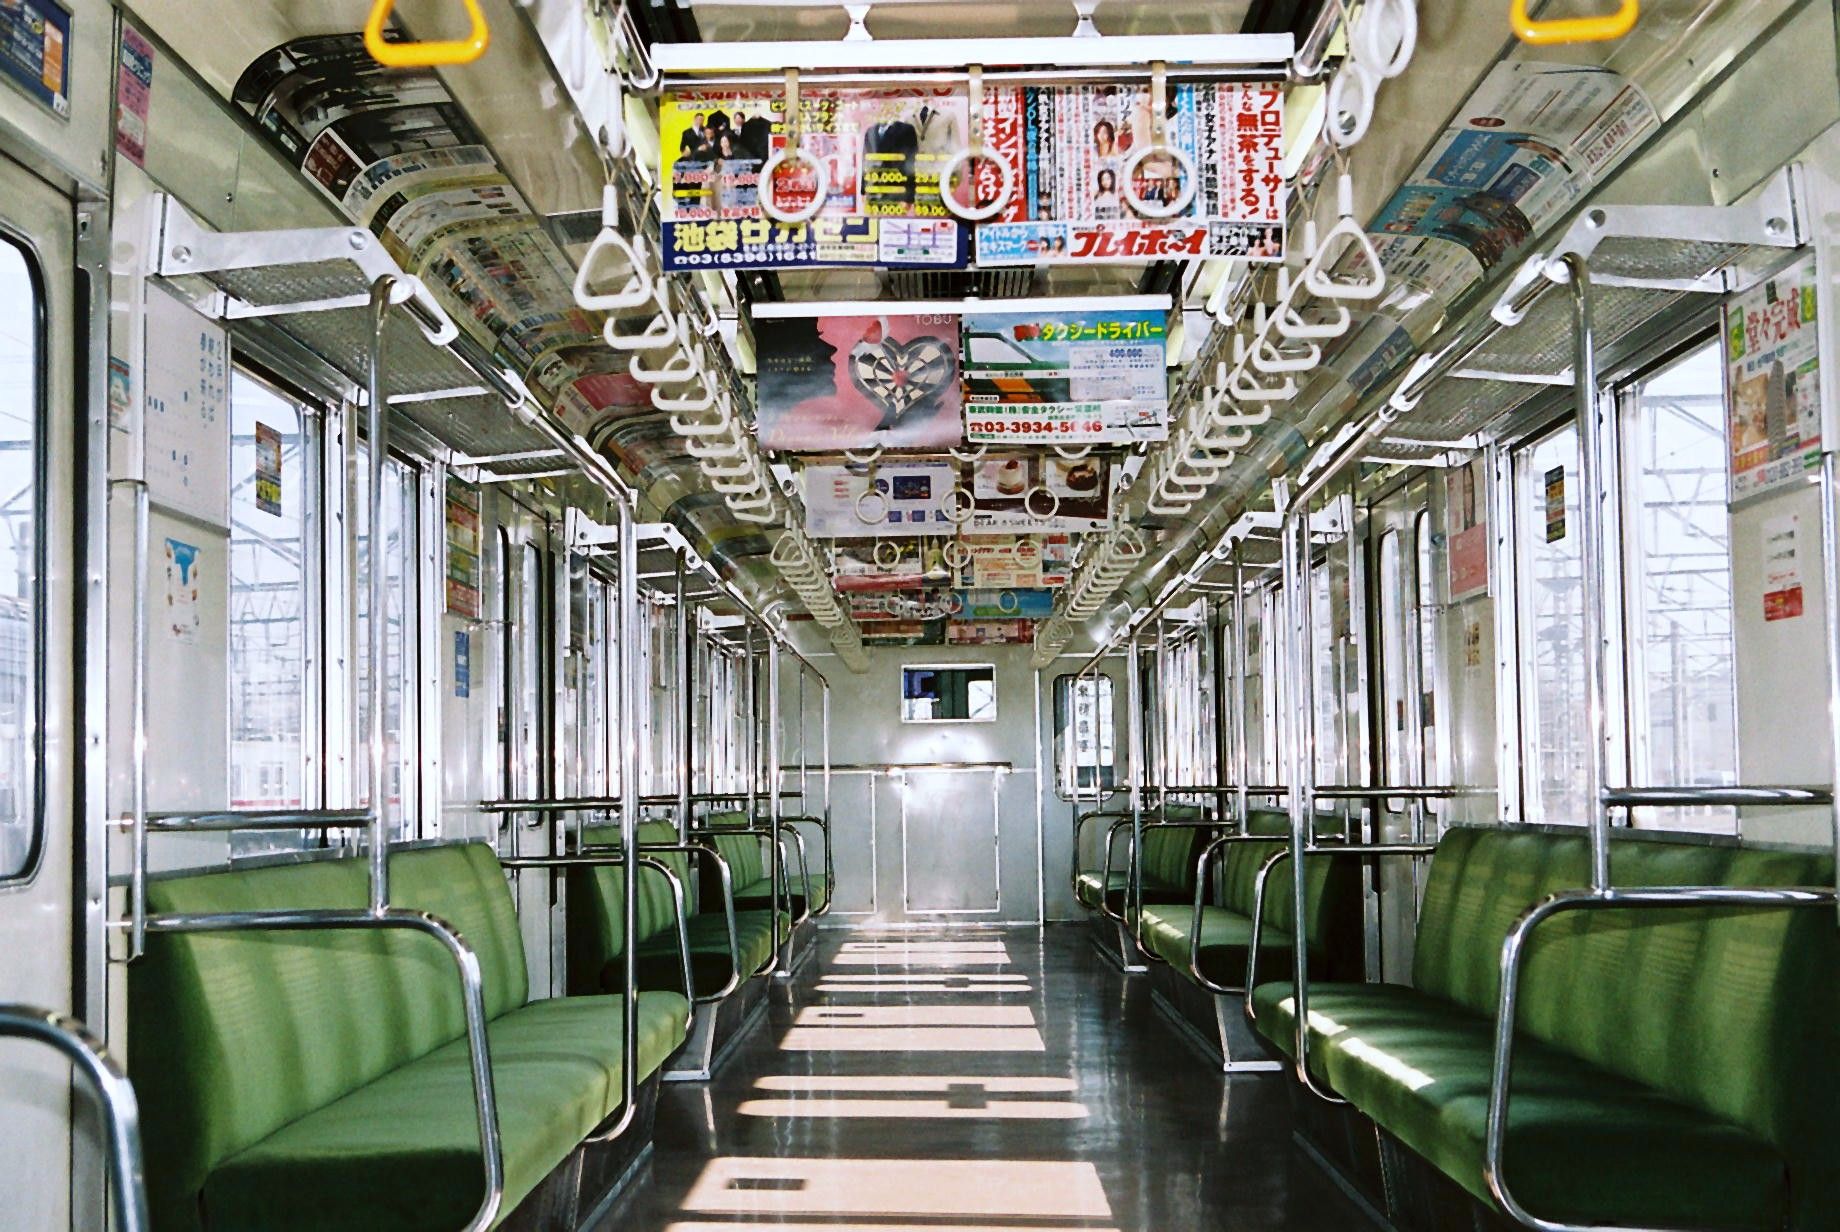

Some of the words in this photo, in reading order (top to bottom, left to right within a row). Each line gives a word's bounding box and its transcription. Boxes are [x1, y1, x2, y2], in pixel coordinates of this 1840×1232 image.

[1070, 223, 1208, 258] プレイボーイ
[1042, 320, 1163, 340] タクシードライバー
